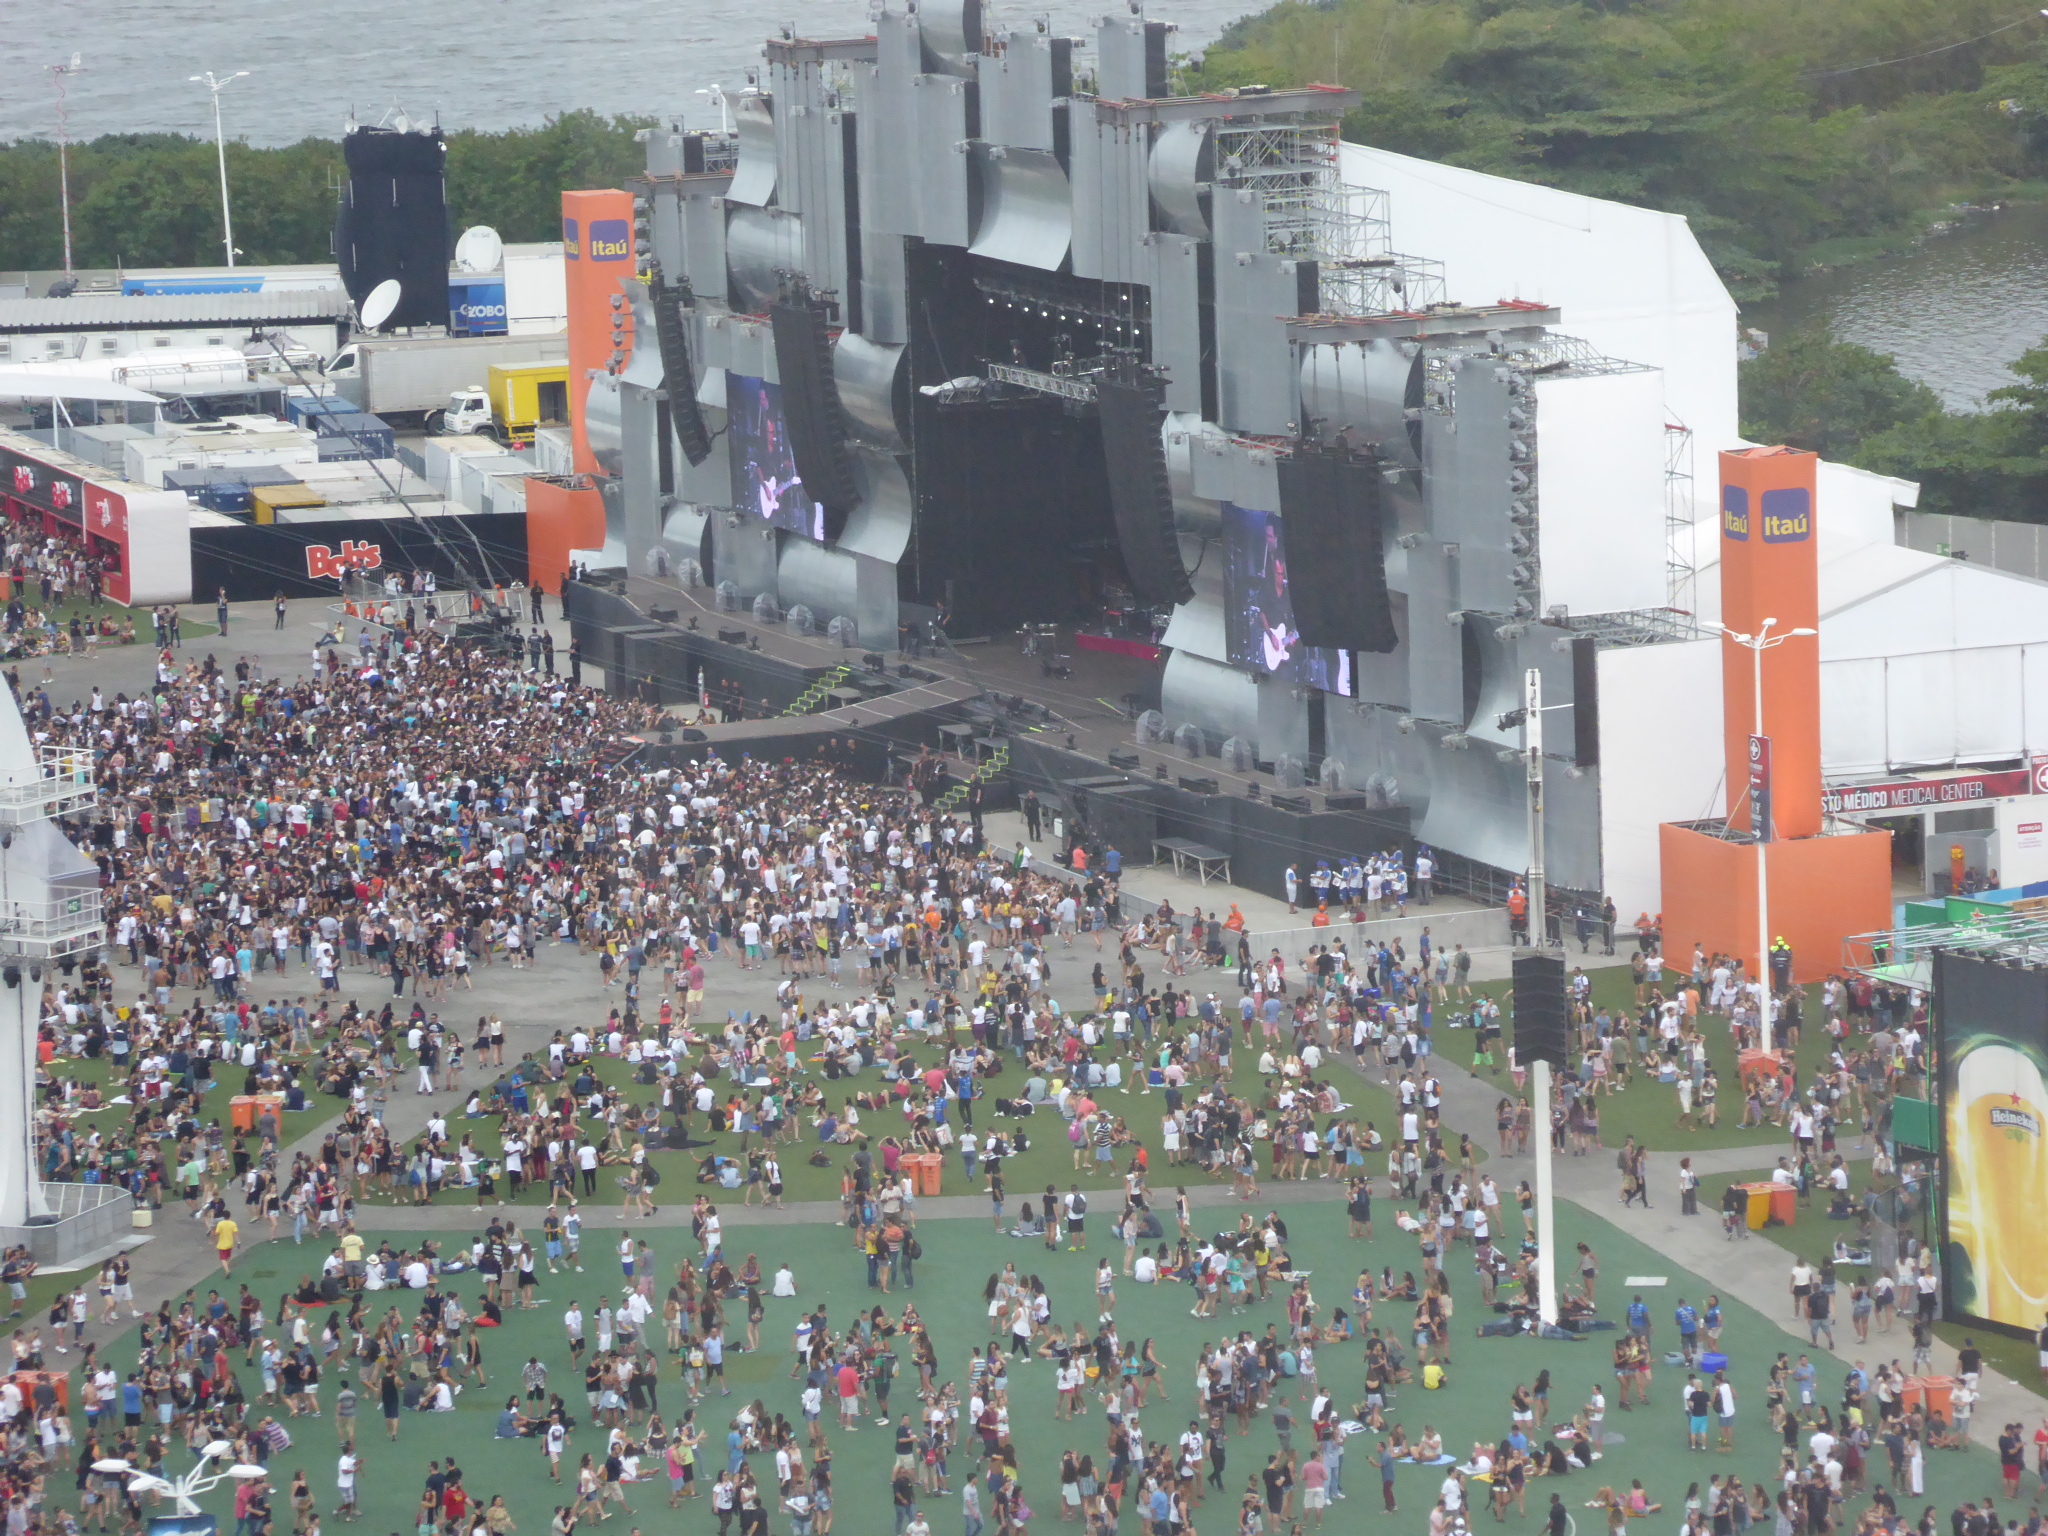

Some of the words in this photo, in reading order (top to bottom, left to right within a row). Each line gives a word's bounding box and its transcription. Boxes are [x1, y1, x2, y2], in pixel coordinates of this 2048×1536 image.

[592, 239, 628, 256] Itaú
[1724, 509, 1748, 534] Itaú
[1764, 513, 1808, 536] Itaú
[305, 540, 382, 579] Bob's
[1822, 795, 1842, 812] STO
[1843, 790, 1888, 811] MÉDICO
[1891, 786, 1939, 806] MEDICAL
[1941, 781, 1983, 801] CENTER
